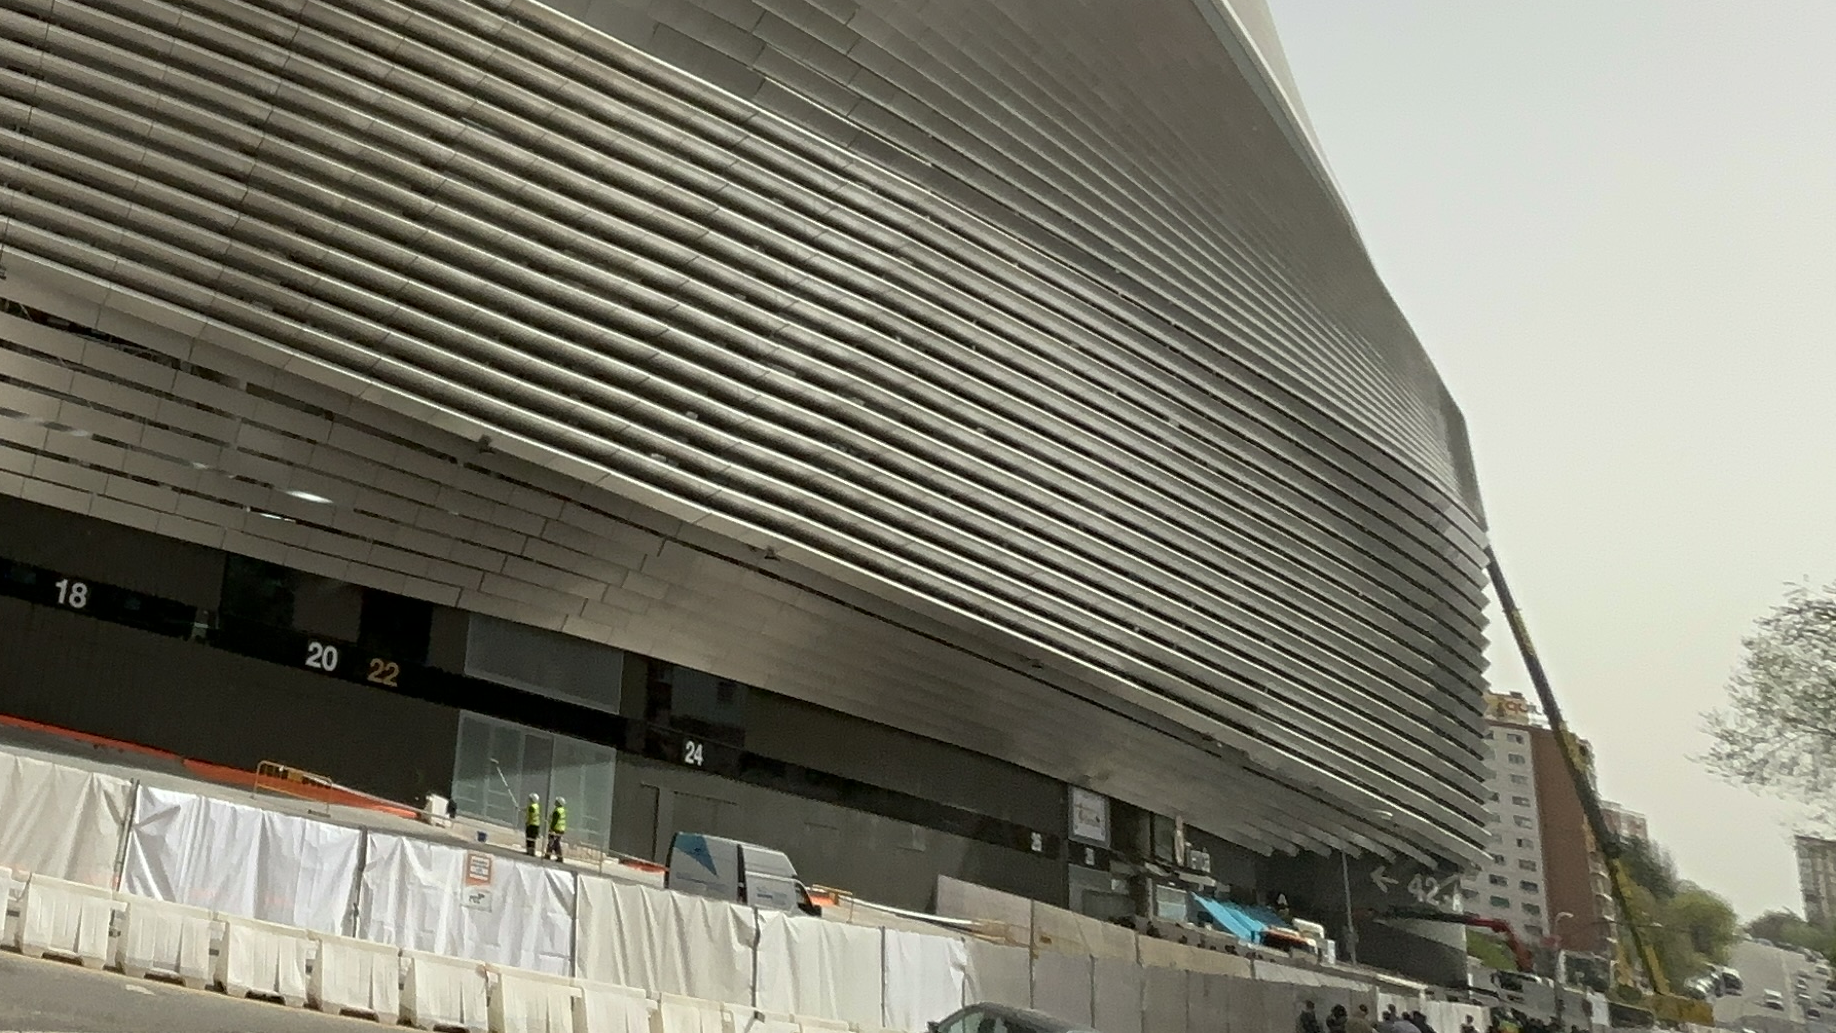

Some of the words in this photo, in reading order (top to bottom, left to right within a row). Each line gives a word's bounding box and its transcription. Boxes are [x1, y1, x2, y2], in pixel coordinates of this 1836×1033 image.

[55, 578, 88, 609] 18
[305, 641, 338, 672] 20
[367, 658, 399, 687] 22
[684, 740, 704, 767] 24
[1407, 873, 1440, 906] 42
